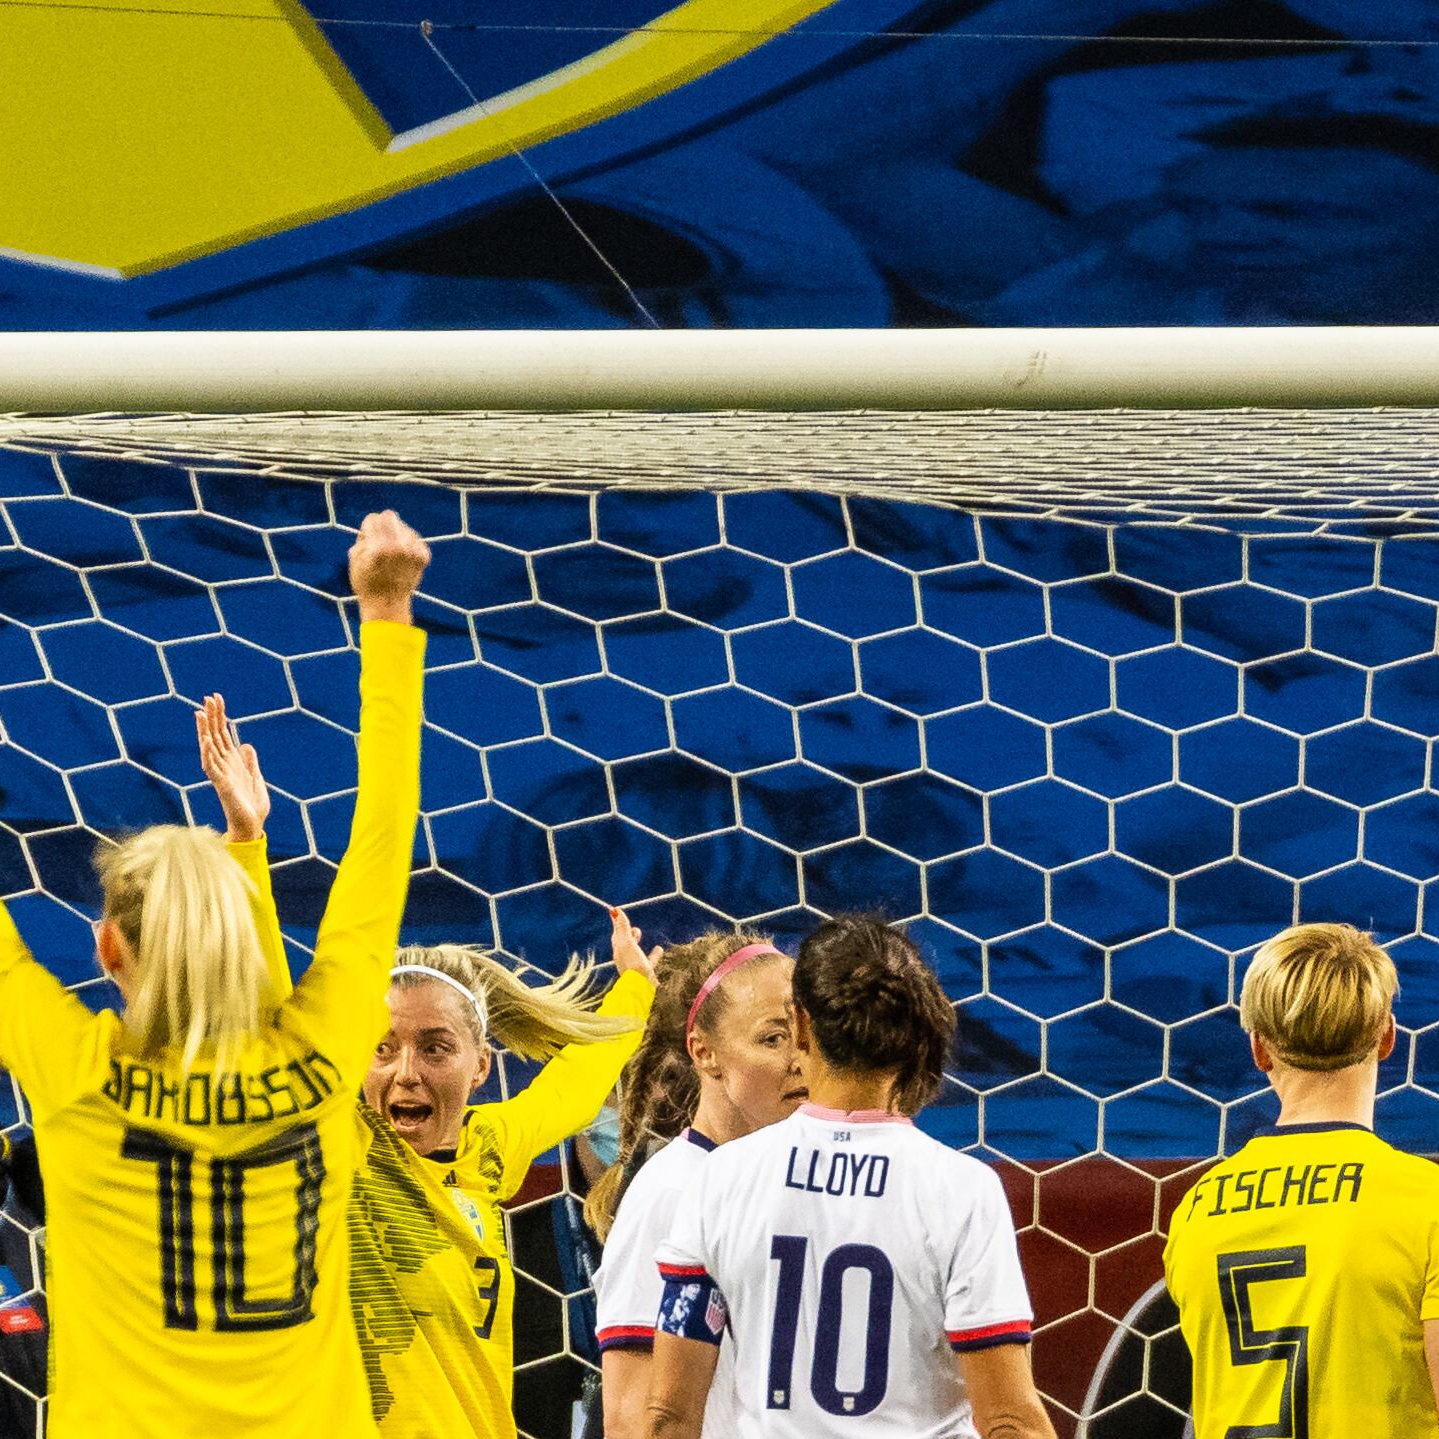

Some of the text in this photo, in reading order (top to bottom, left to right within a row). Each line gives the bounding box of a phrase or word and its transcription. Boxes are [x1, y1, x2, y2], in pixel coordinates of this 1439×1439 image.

[833, 1131, 851, 1142] USA
[785, 1146, 890, 1198] LLOYD
[1186, 1162, 1364, 1222] FISCHER
[120, 1121, 326, 1332] 10
[766, 1234, 895, 1416] 10
